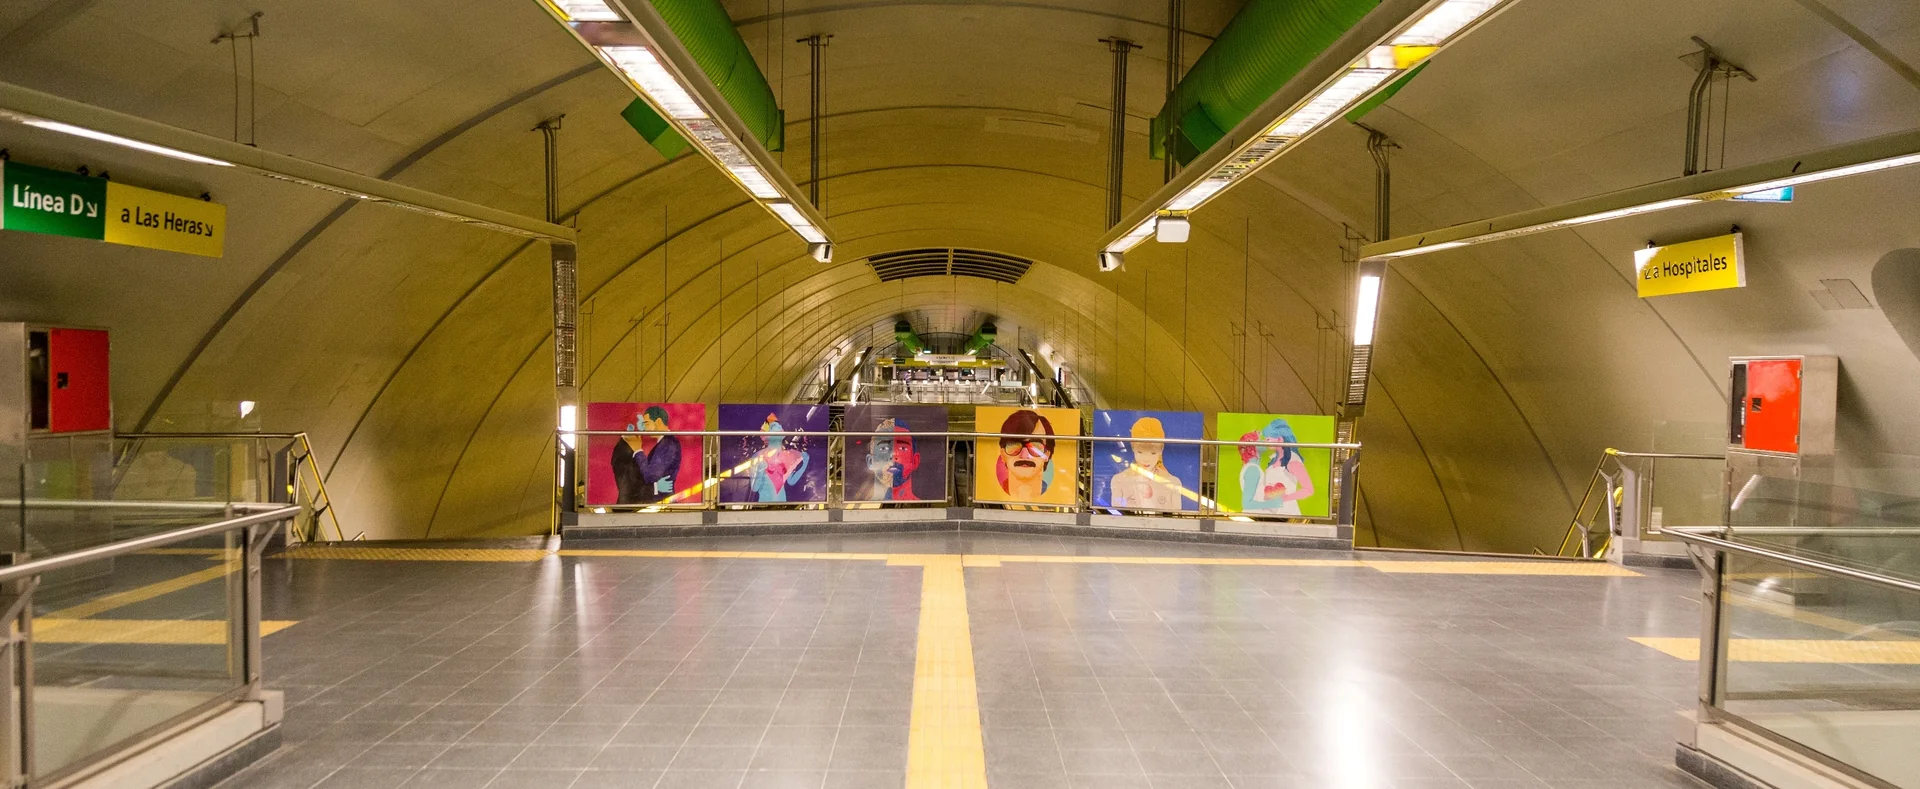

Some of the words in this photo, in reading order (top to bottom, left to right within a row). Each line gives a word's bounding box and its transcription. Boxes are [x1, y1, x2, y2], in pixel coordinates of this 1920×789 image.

[12, 184, 65, 213] Línea
[71, 194, 84, 215] D
[121, 208, 130, 223] a
[136, 206, 160, 228] Las
[164, 212, 203, 236] Heras
[1653, 265, 1660, 279] a
[1663, 254, 1727, 279] Hospitales
